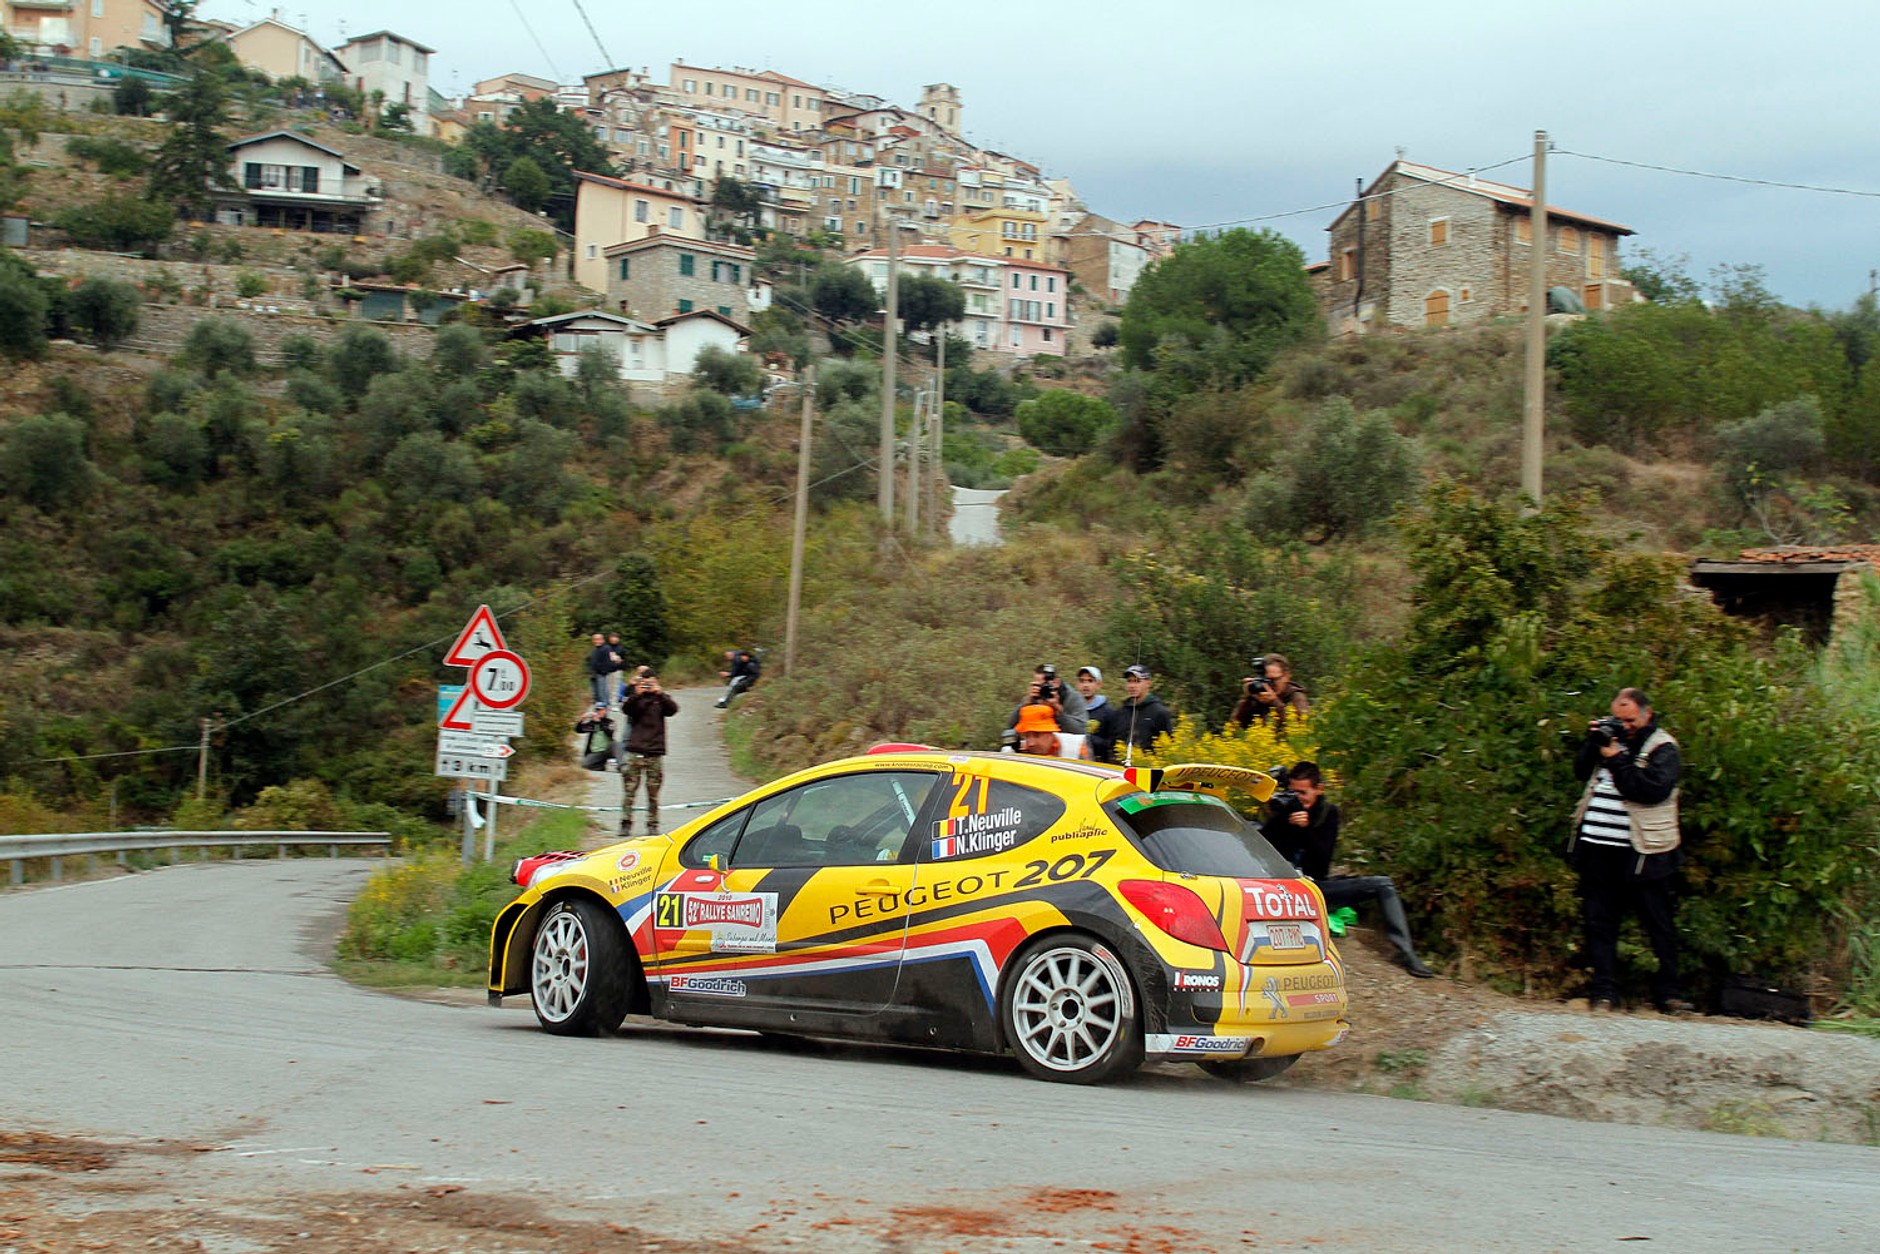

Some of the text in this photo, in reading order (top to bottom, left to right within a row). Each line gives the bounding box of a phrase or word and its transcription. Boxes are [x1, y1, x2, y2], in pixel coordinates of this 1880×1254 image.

[948, 771, 991, 819] 21
[956, 807, 1022, 835] T.Neuville
[956, 829, 1017, 856] N.Klinger
[619, 866, 652, 882] Neuville
[621, 875, 652, 890] Klinger
[830, 849, 1117, 925] PEUGEOT 207
[659, 894, 680, 926] 21
[1244, 887, 1317, 917] TOTAL
[700, 903, 726, 921] RALLYE
[726, 902, 761, 924] SANREMO
[671, 976, 746, 993] BFGoodrich
[1174, 969, 1220, 987] KRONOS
[1283, 974, 1335, 991] PEUGEOT
[1314, 993, 1337, 1004] SPORT
[1175, 1036, 1251, 1050] BFGoodrich
